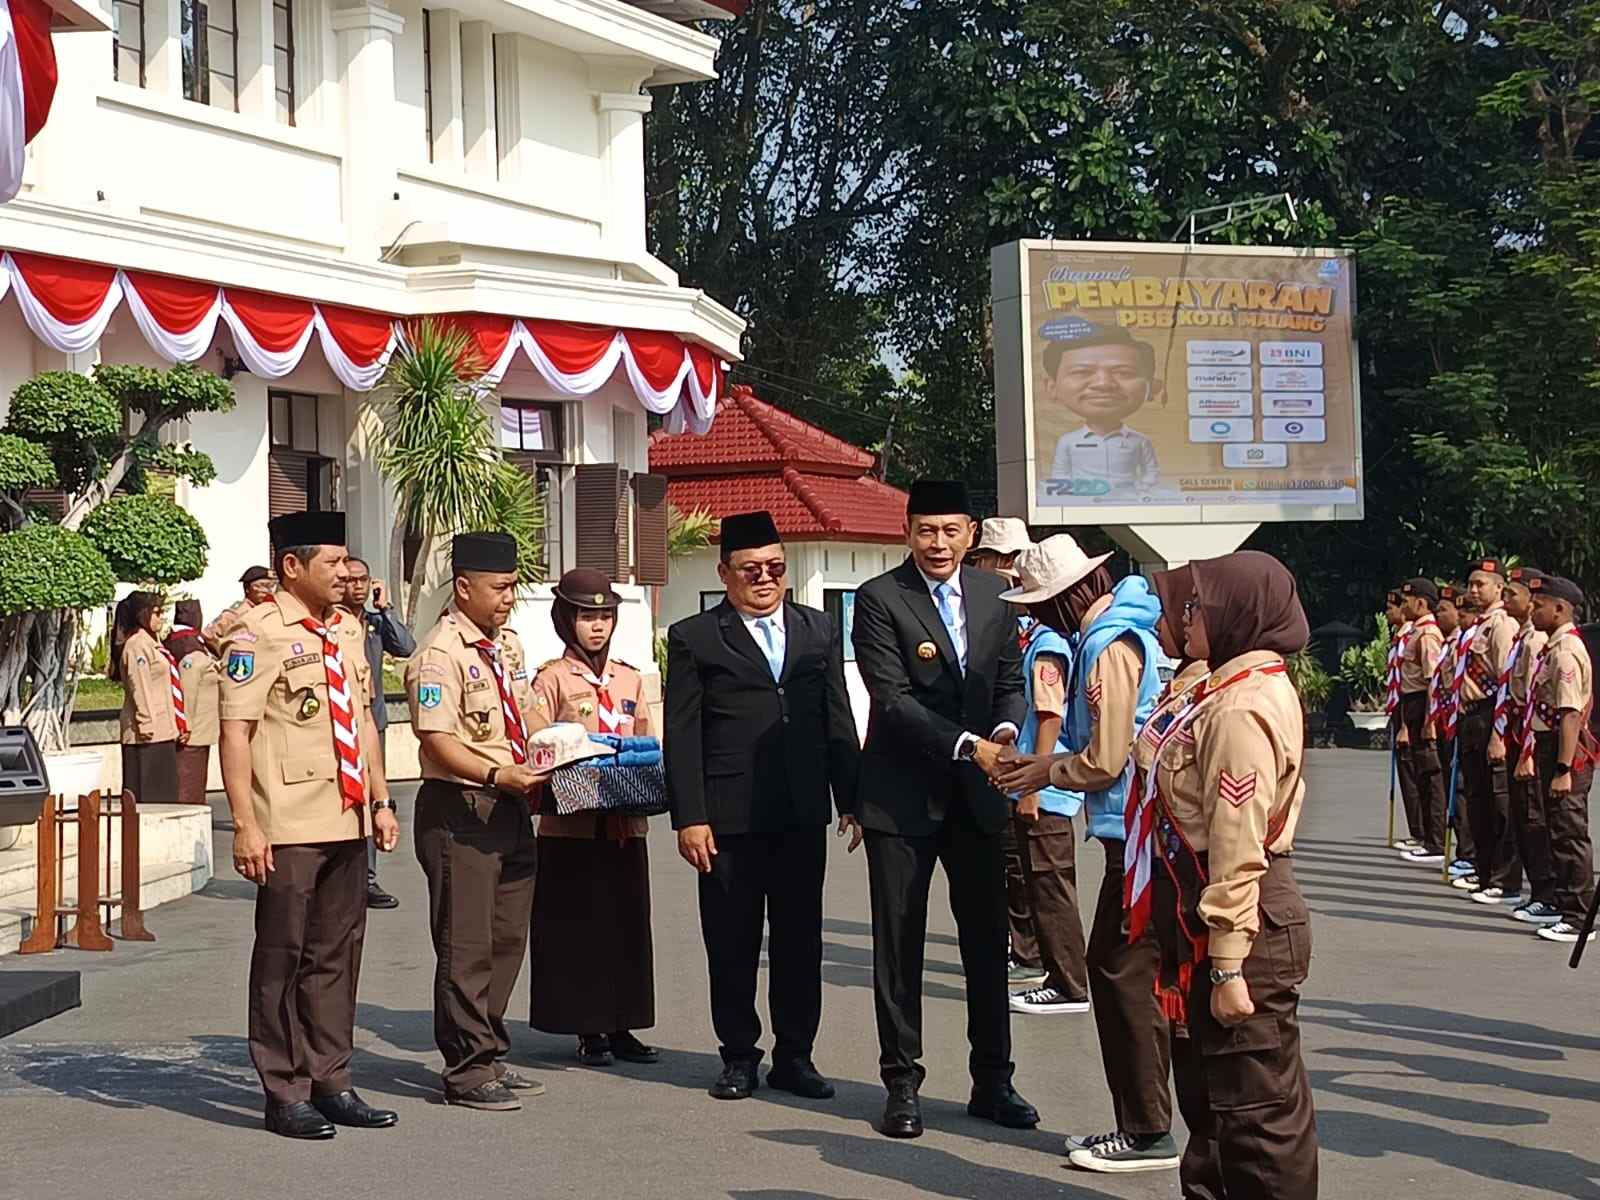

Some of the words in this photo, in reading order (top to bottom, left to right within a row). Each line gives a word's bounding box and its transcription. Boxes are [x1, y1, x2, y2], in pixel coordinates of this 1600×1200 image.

[1045, 277, 1333, 315] PEMBAYARAN
[1117, 309, 1176, 329] PBB
[1178, 310, 1234, 327] KOTA
[1239, 313, 1326, 332] MALANG
[1285, 348, 1311, 358] BNI
